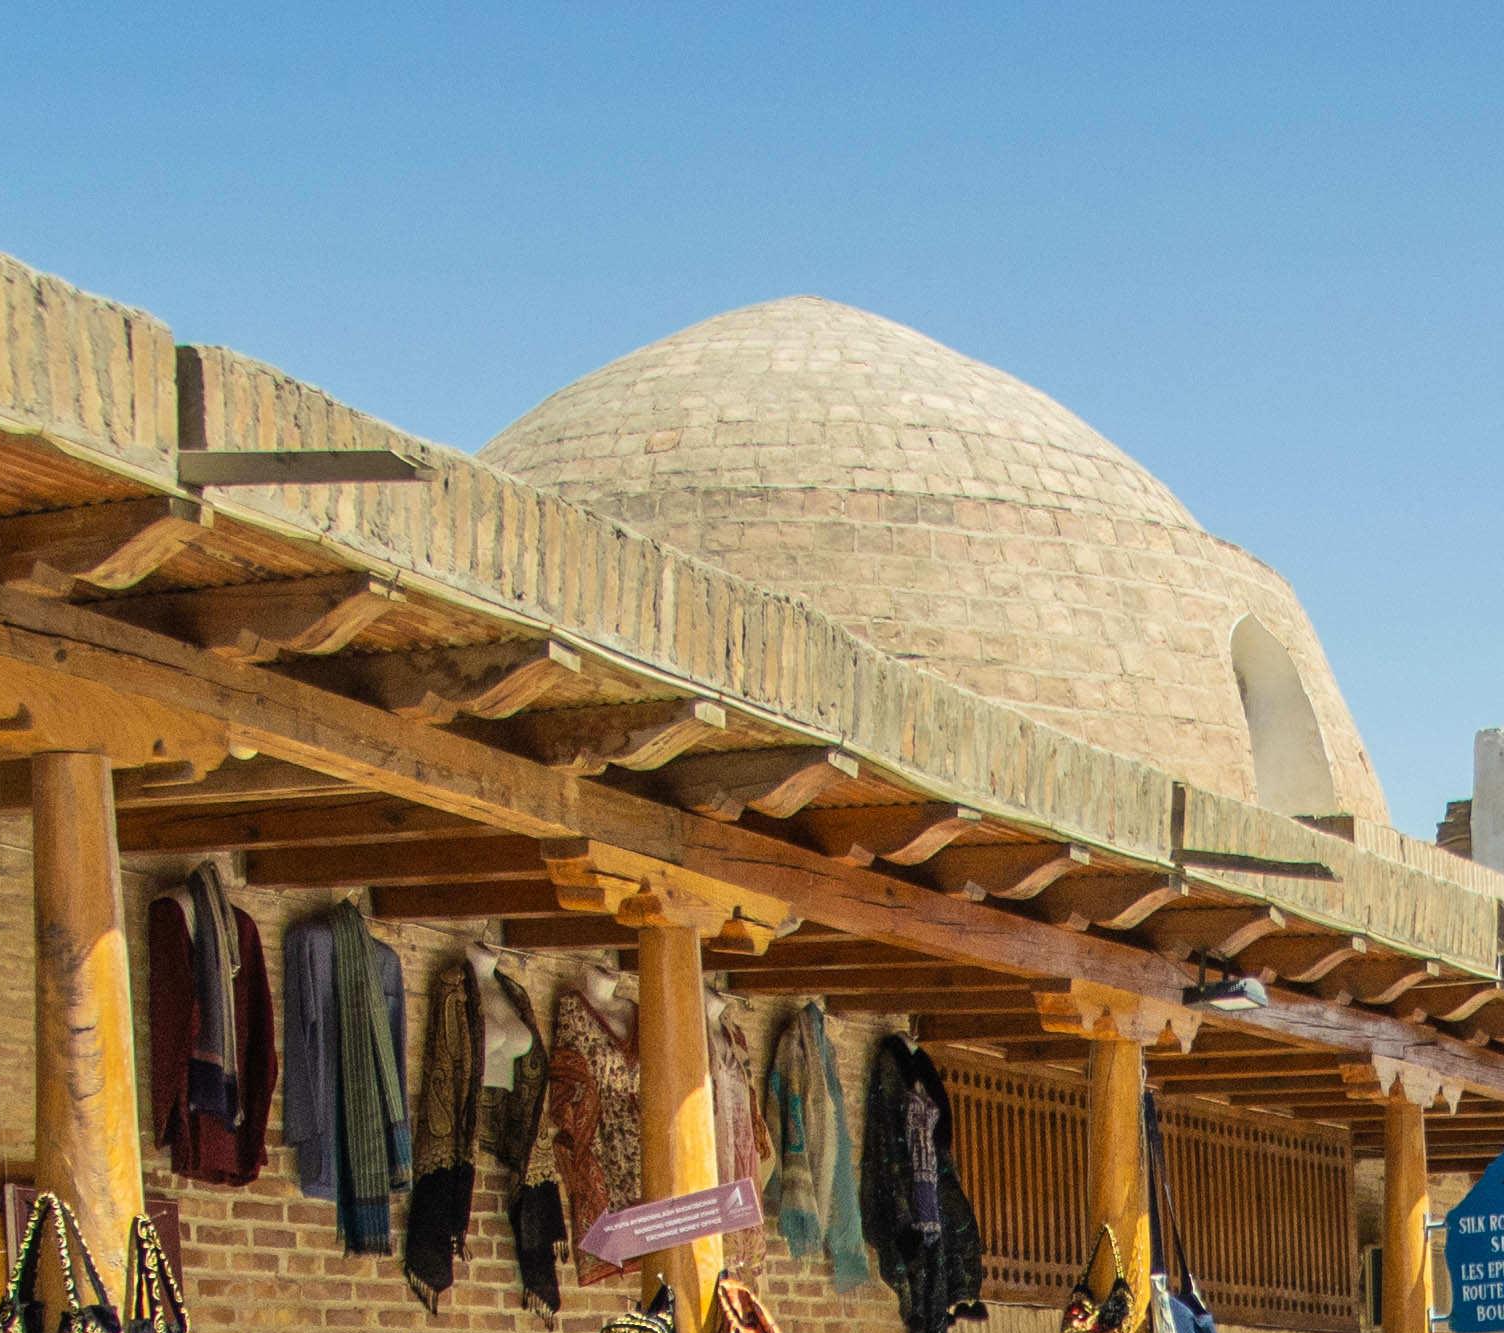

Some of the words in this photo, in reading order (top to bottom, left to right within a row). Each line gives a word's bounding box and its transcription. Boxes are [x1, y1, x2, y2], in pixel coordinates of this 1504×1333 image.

[1458, 1214, 1485, 1234] SILK
[1461, 1263, 1485, 1281] LES
[1462, 1283, 1504, 1302] ROUTE
